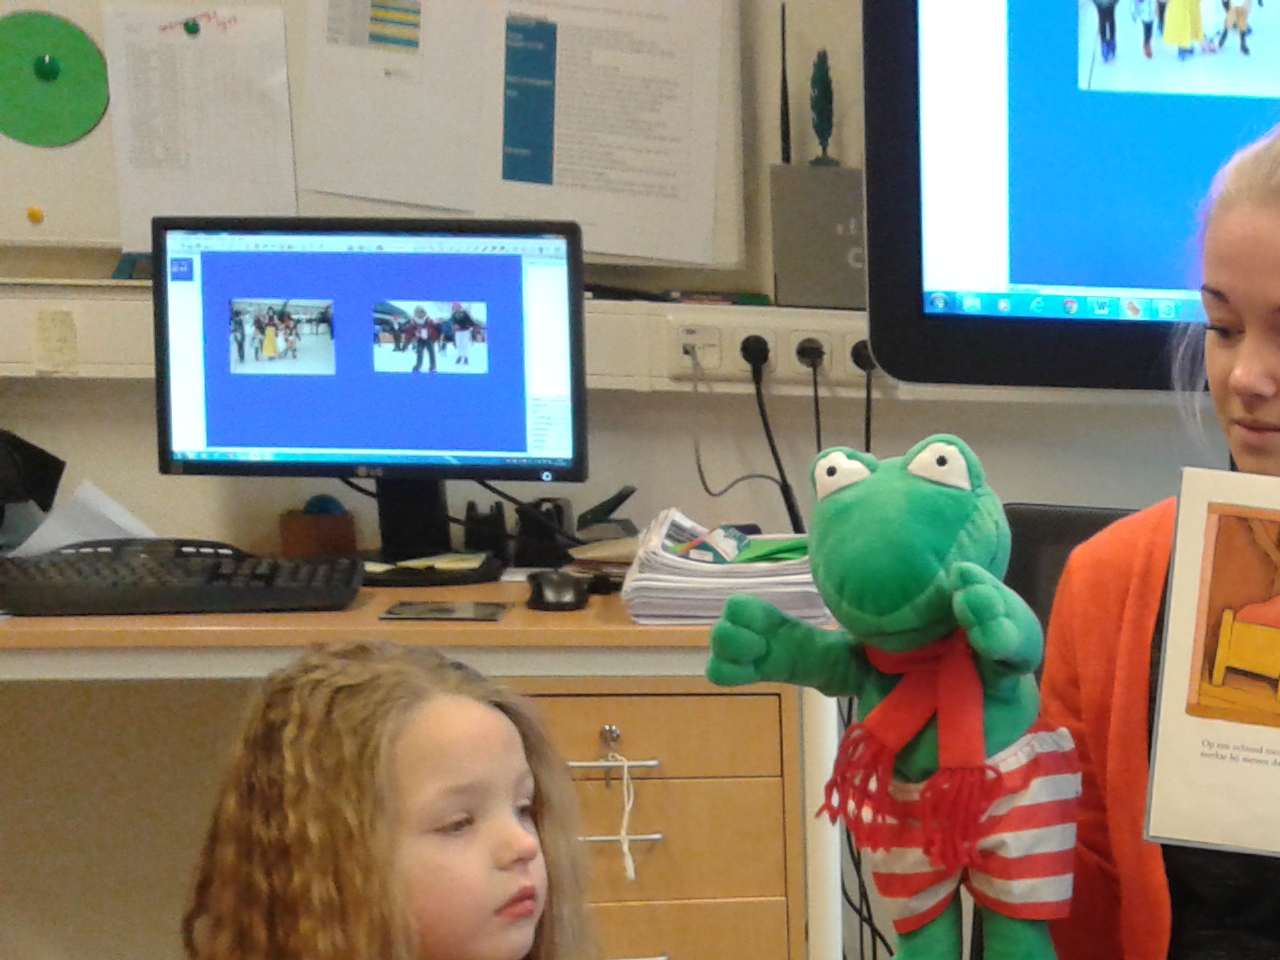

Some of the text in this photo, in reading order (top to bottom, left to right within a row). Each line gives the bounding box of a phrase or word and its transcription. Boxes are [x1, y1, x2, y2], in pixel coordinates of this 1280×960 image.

[1201, 739, 1215, 751] Op
[1217, 742, 1230, 751] een
[1232, 743, 1264, 754] ochtend
[1200, 750, 1227, 760] merkte
